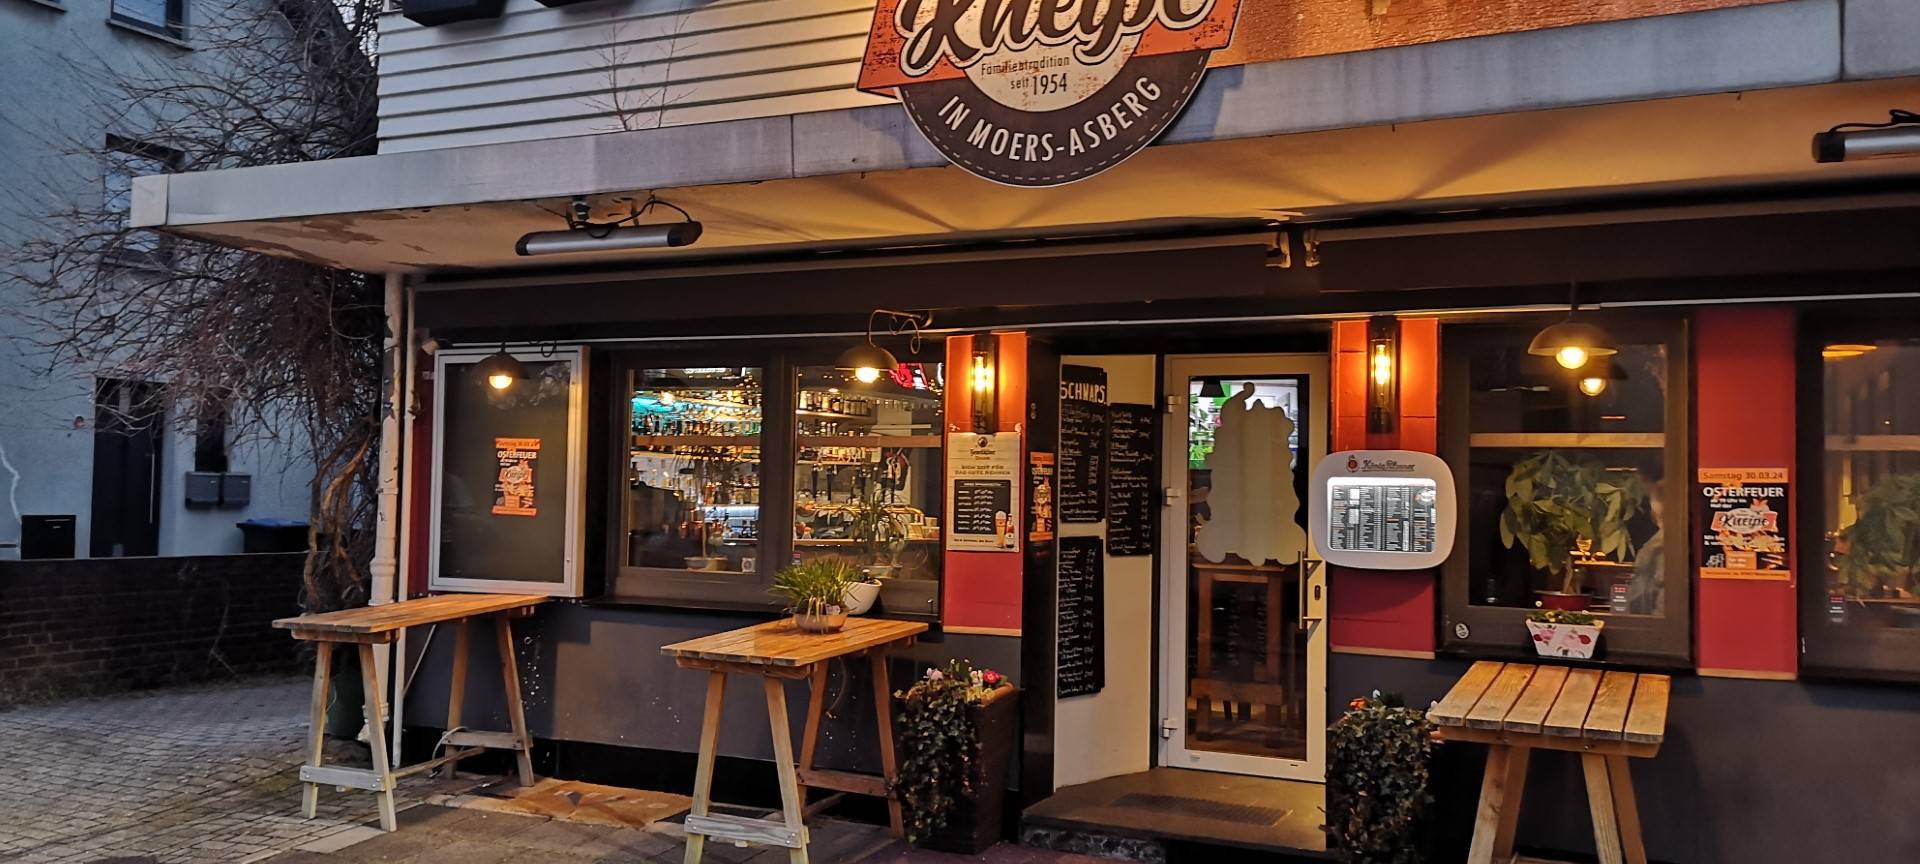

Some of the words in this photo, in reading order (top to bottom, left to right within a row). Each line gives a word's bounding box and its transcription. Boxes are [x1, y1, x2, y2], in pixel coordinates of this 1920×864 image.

[1010, 77, 1029, 90] seit
[1032, 72, 1068, 96] 1954
[938, 95, 971, 131] IN
[966, 77, 1162, 162] MOERS-ASBERG
[1703, 471, 1742, 480] Samstag
[1745, 472, 1783, 480] 30.03.24
[1703, 487, 1784, 497] OSTERFEUER
[1720, 513, 1768, 528] Kneipe
